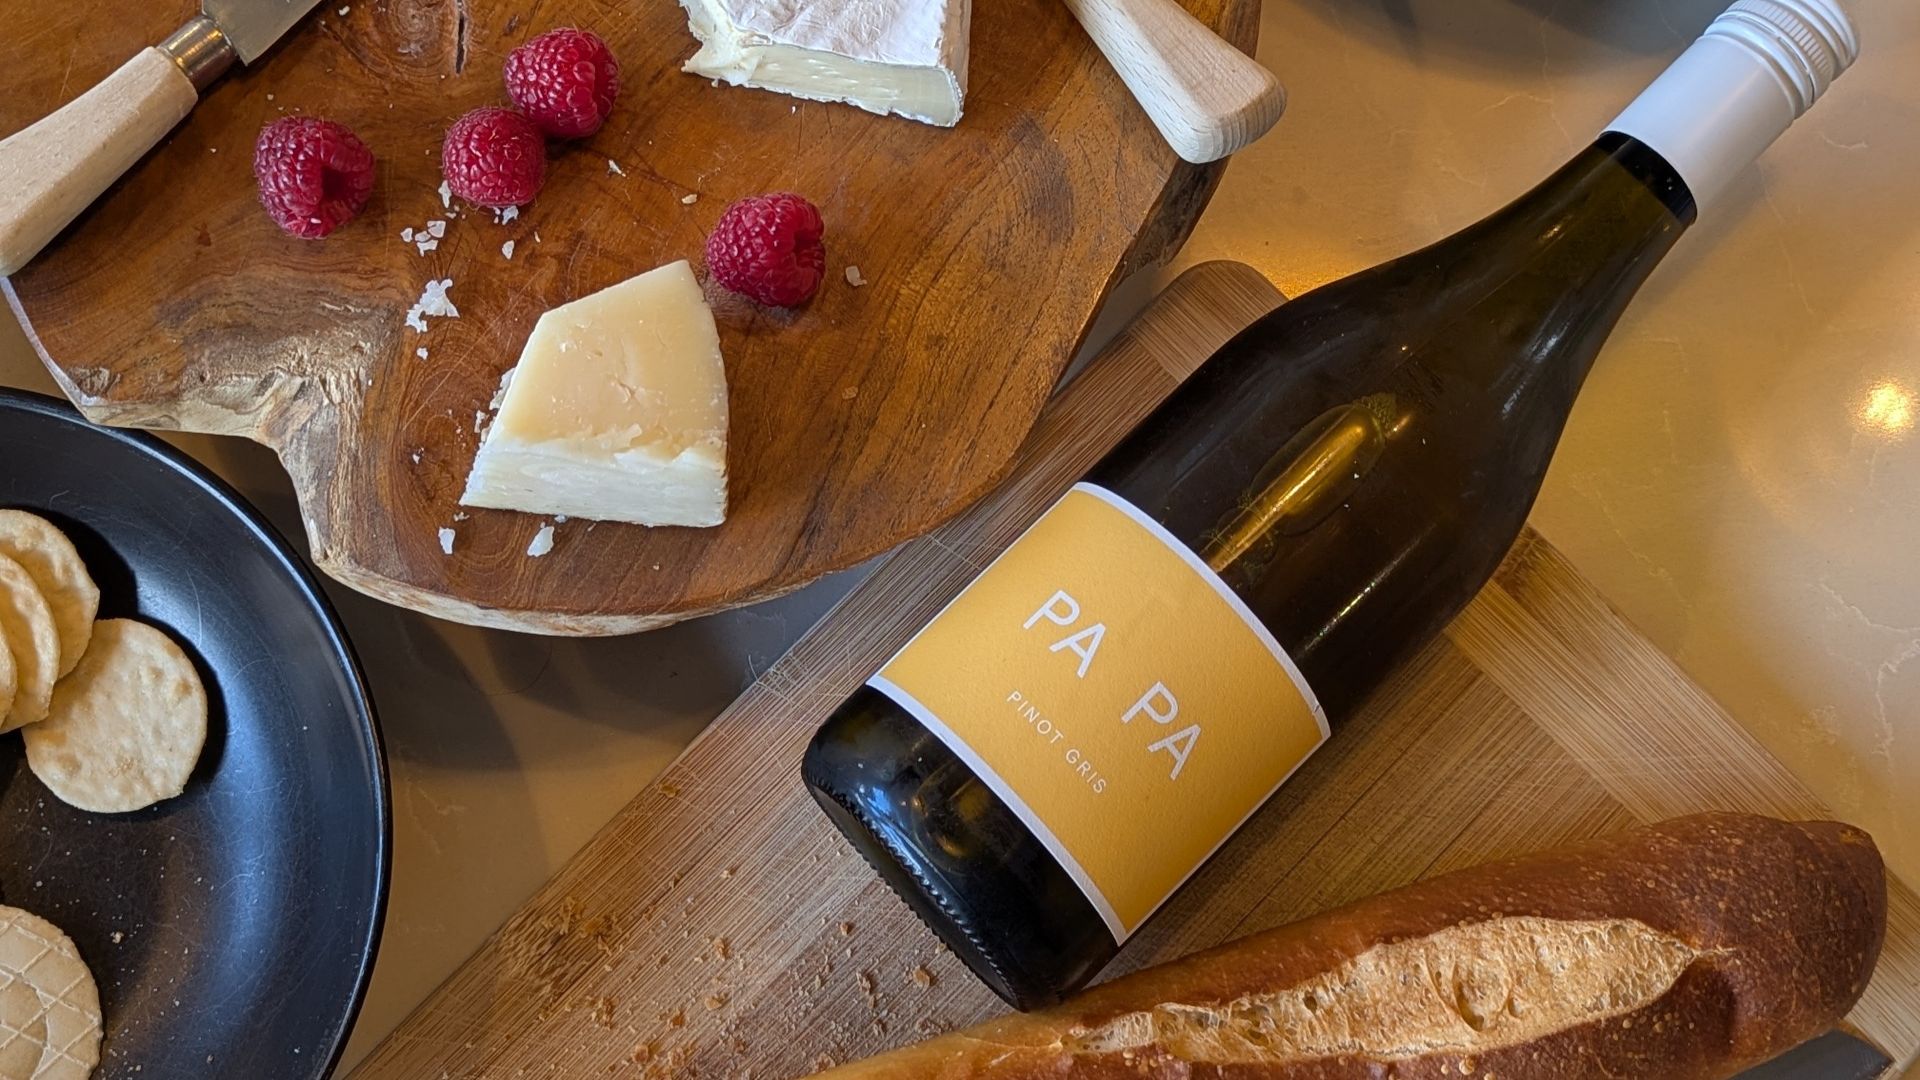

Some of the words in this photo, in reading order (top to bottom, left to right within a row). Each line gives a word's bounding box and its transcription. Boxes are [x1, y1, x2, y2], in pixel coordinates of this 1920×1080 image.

[1005, 690, 1064, 745] PINOT
[1065, 748, 1108, 795] GRIS
[1022, 589, 1107, 679] PA
[1121, 681, 1201, 781] PA
